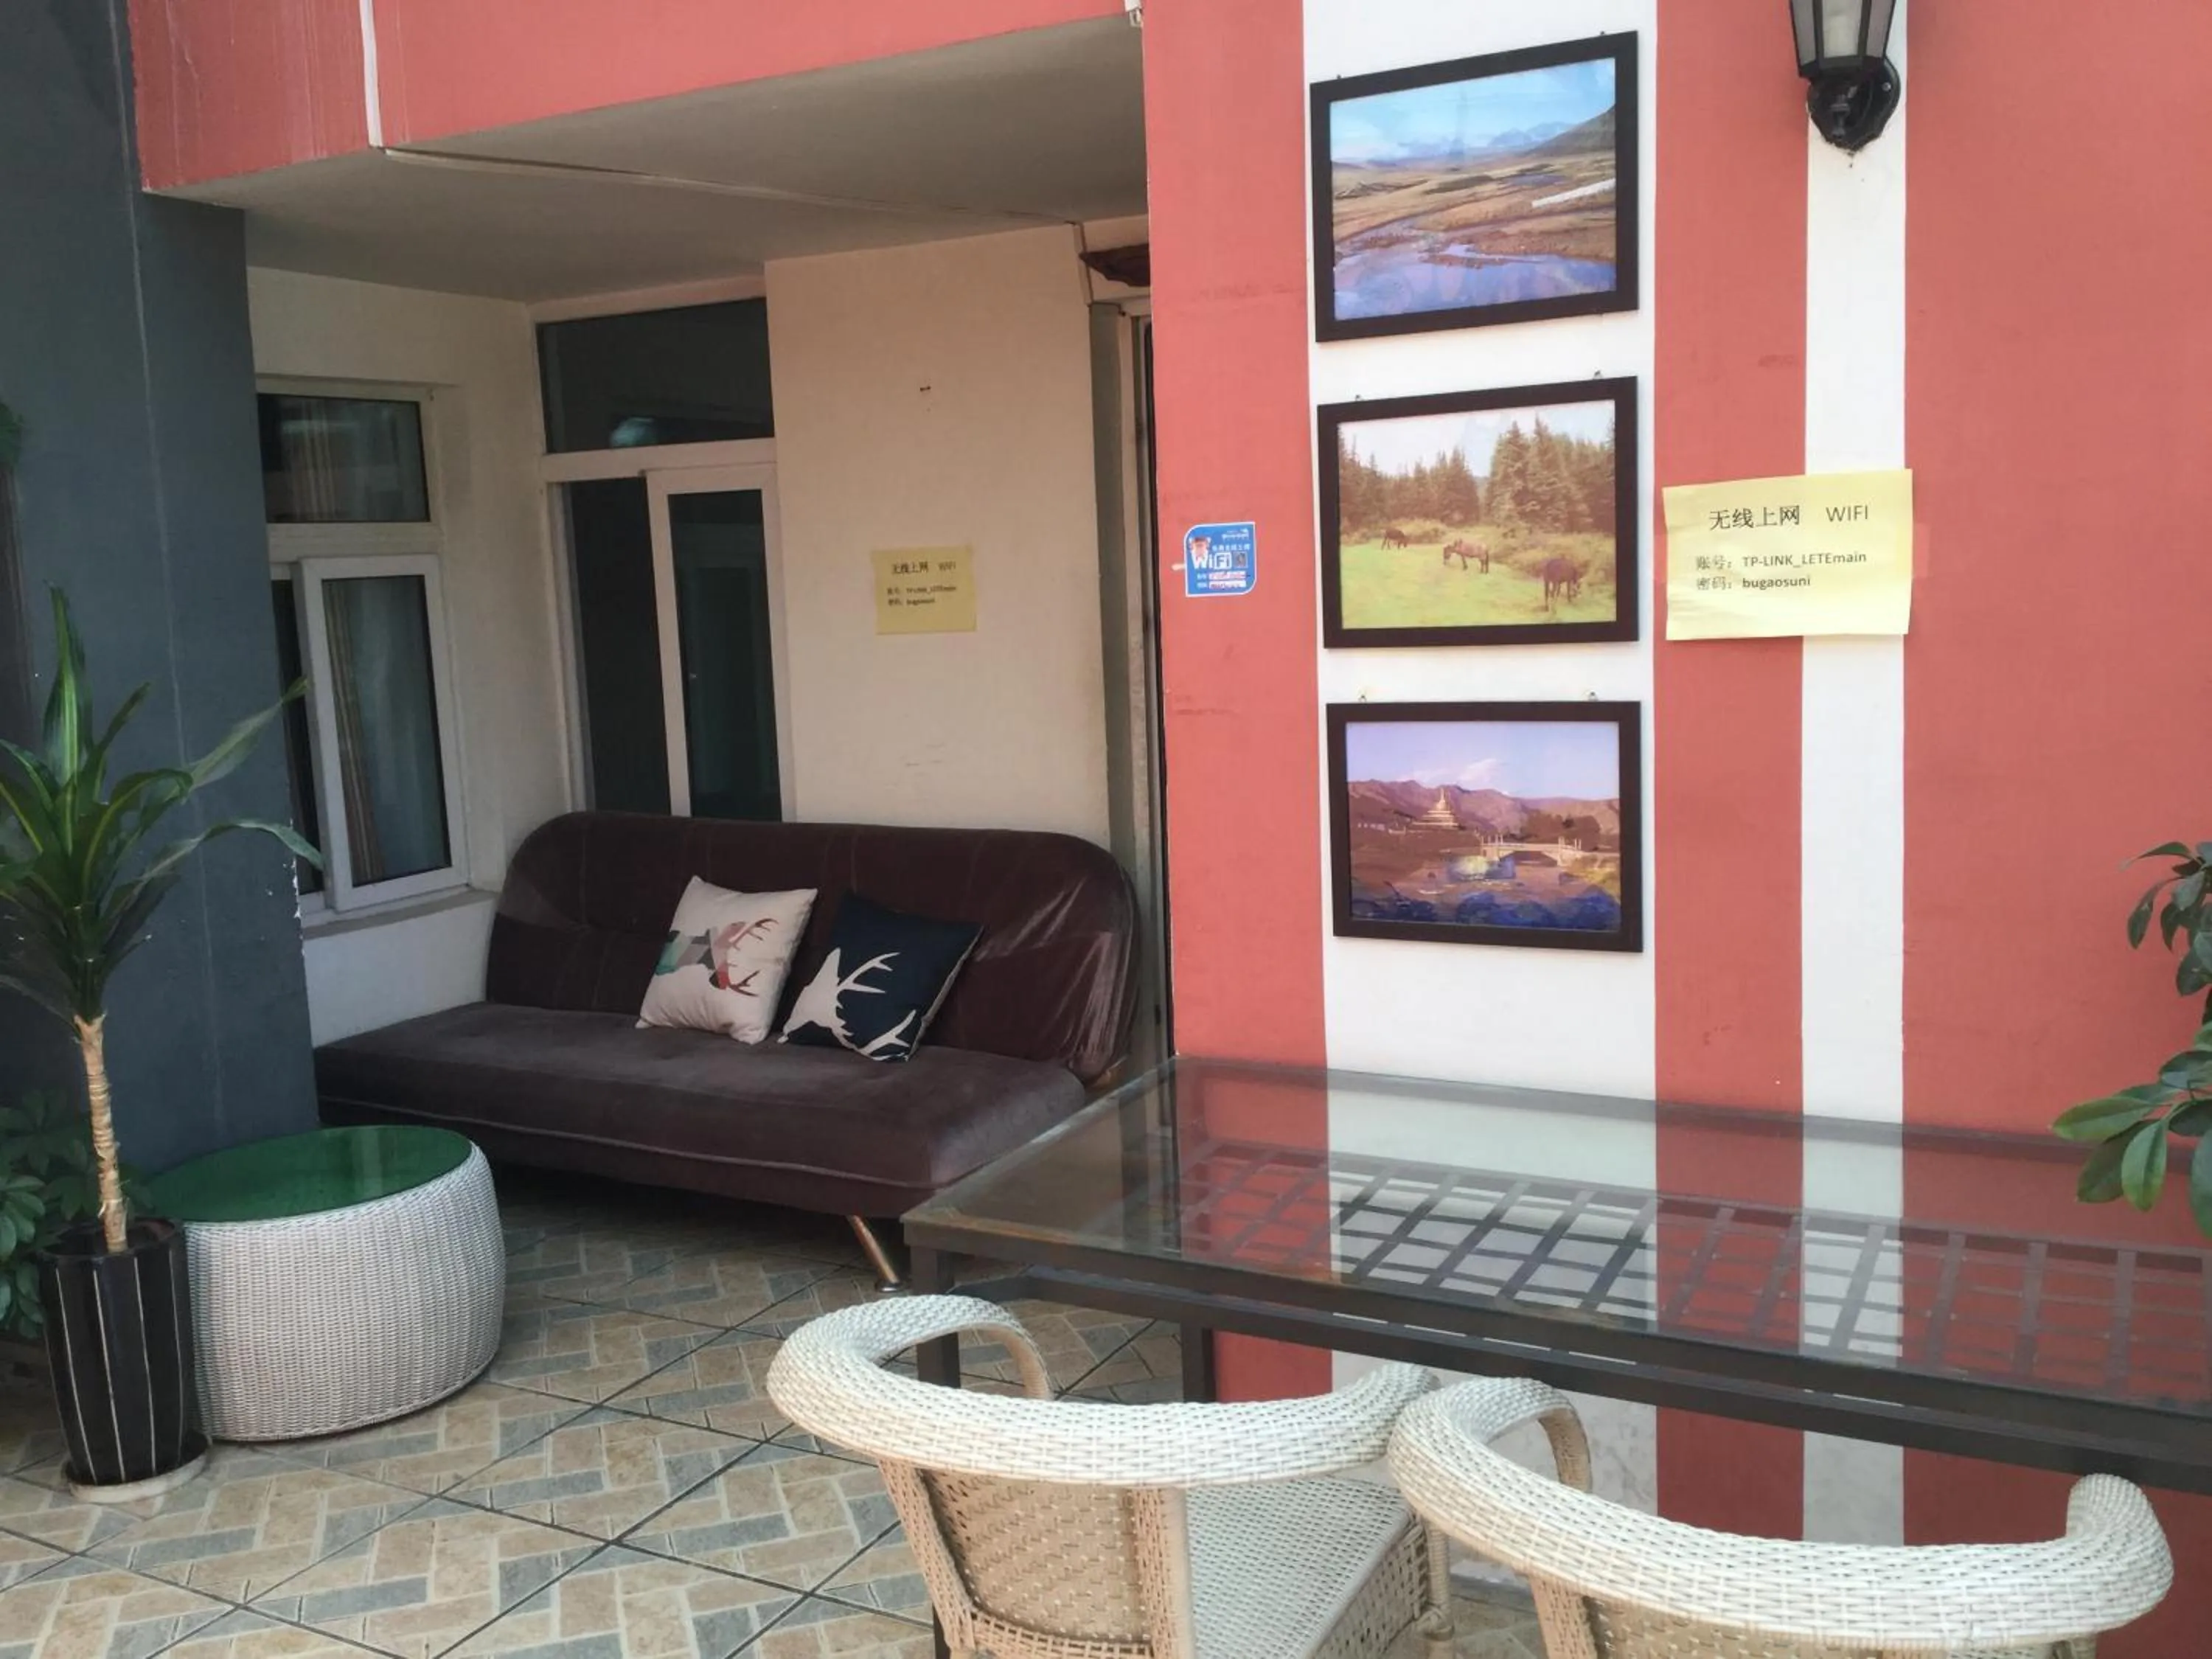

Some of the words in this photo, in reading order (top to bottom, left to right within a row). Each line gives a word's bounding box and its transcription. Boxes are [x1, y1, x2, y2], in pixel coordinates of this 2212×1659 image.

[1709, 504, 1801, 530] 无线上网
[1826, 504, 1869, 523] WIFI
[1742, 552, 1867, 568] TP-LINK_LETEmain
[1742, 576, 1811, 591] bugaosuni
